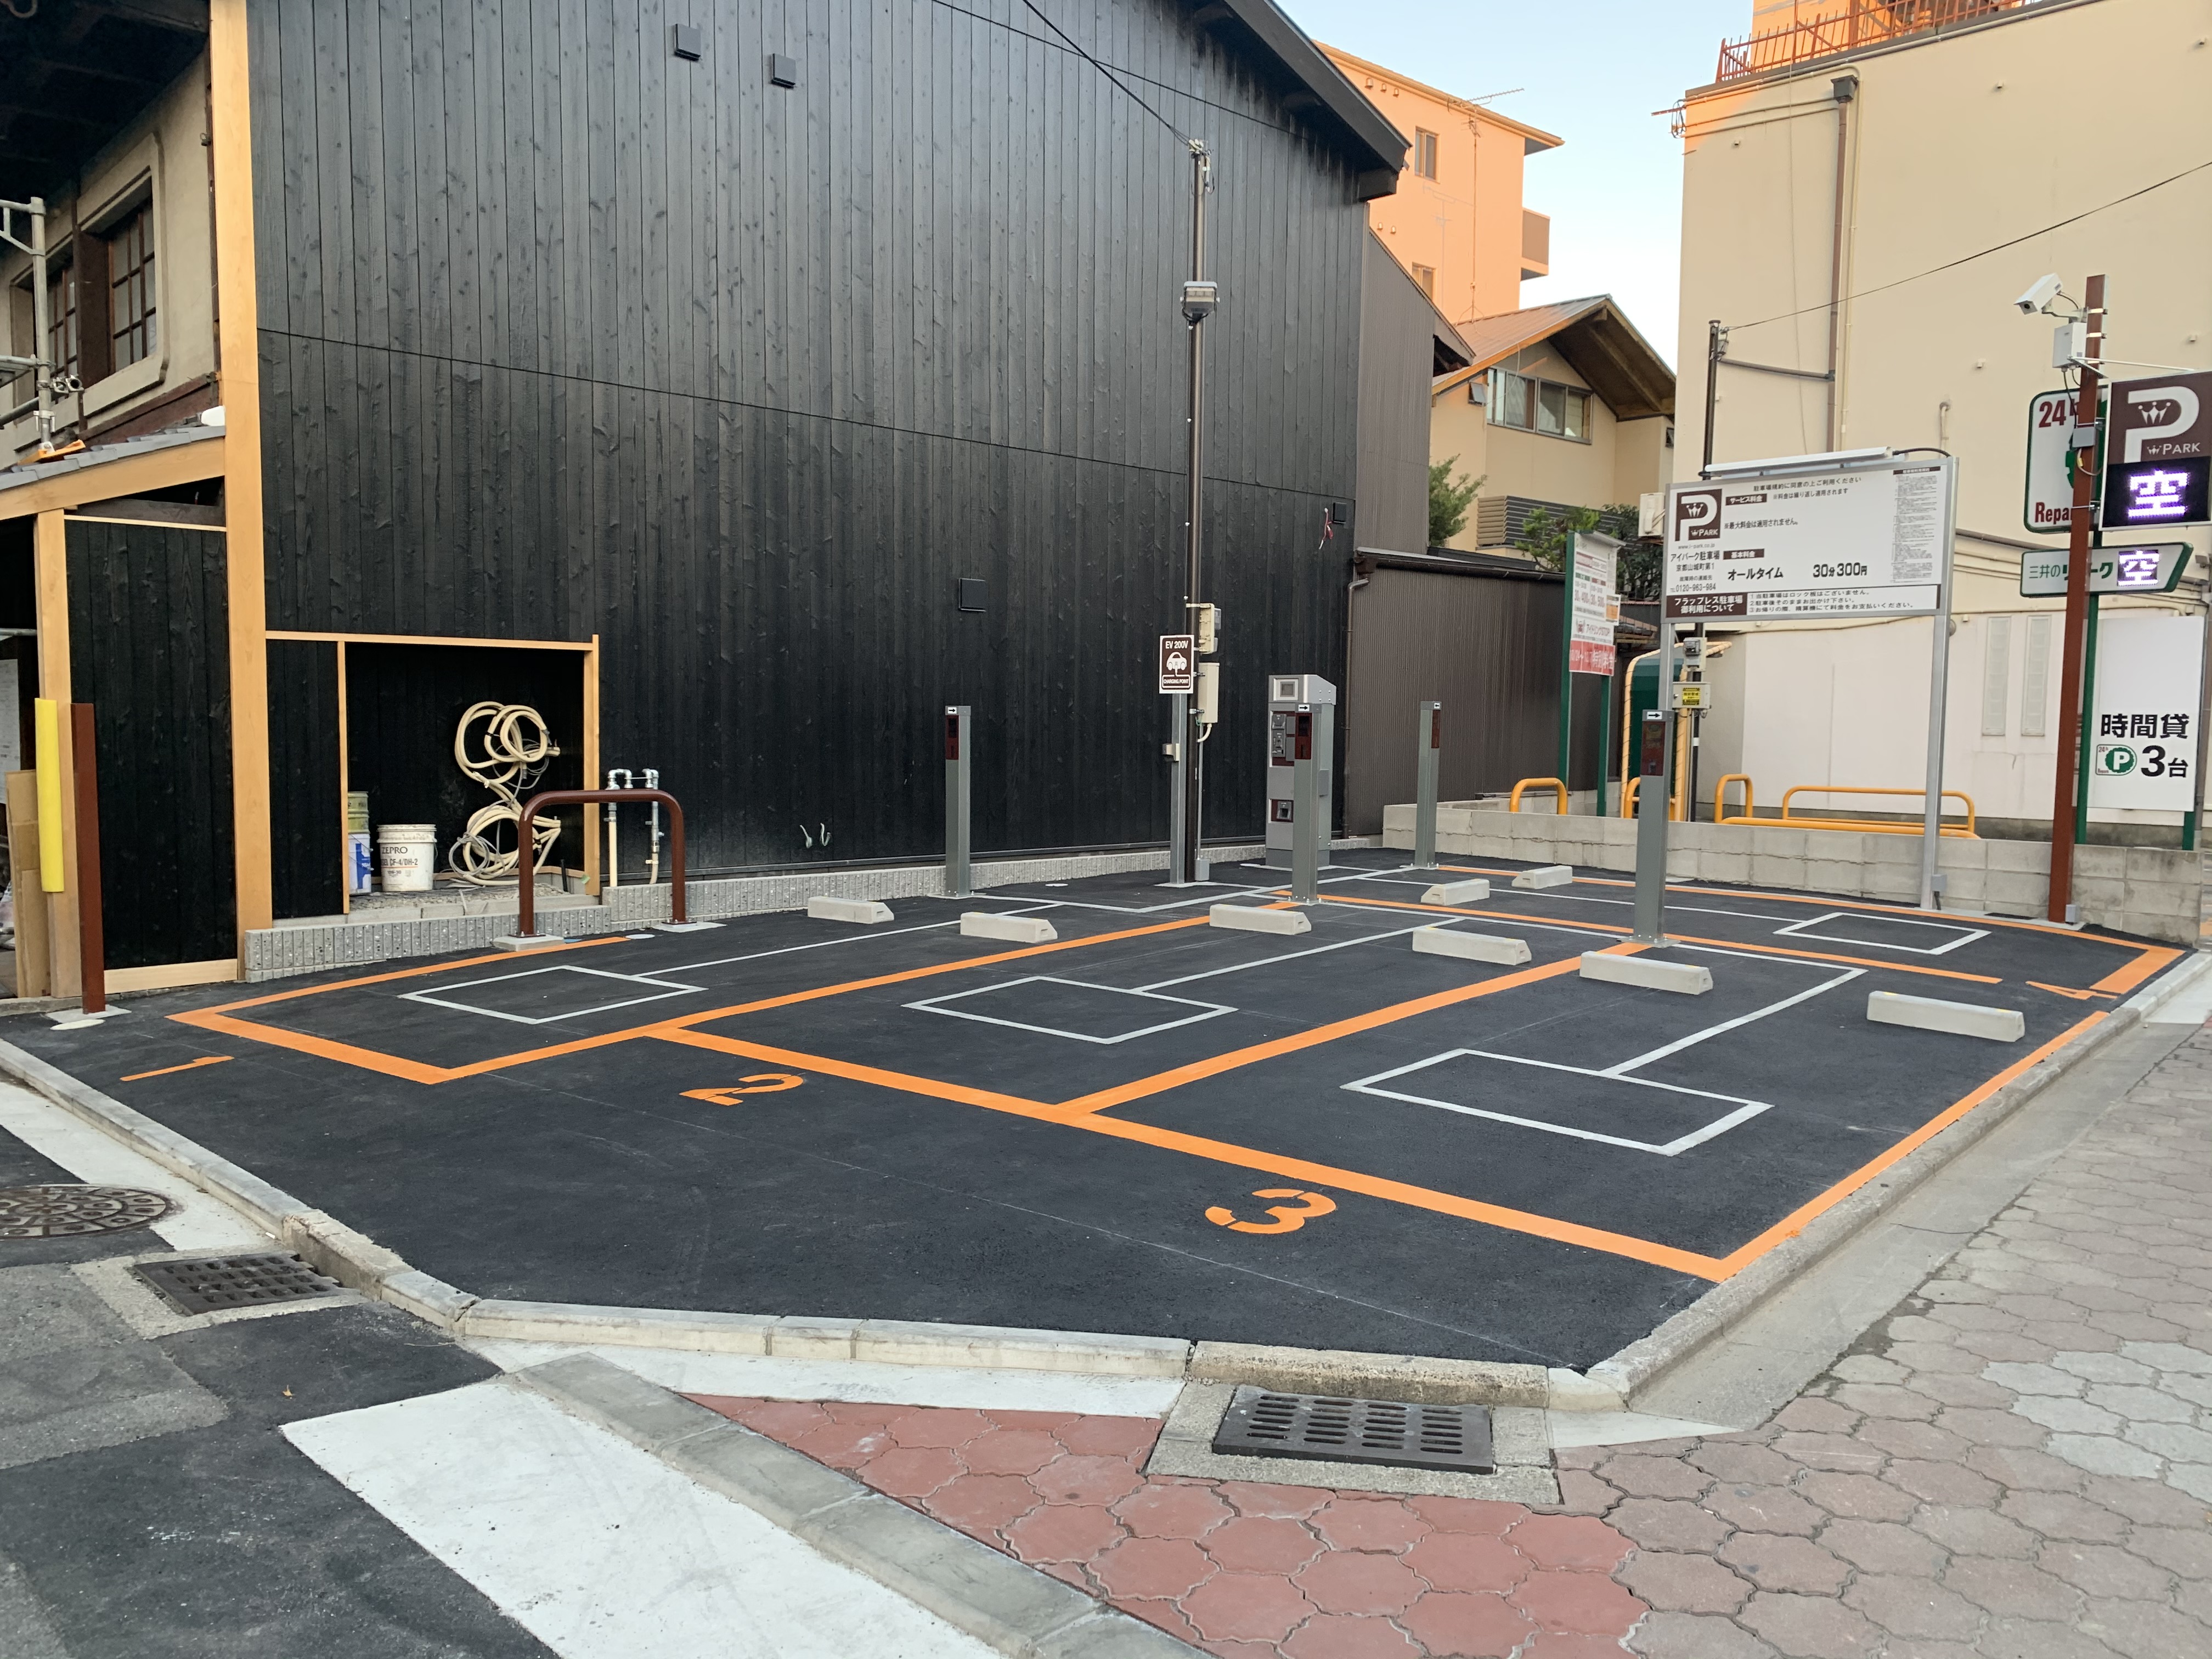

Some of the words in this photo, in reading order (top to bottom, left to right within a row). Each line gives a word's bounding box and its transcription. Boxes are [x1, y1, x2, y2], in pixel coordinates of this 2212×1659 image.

[2163, 443, 2200, 455] PARK
[1730, 495, 1763, 504] サービス料金
[2128, 470, 2190, 518] 空
[2035, 501, 2072, 524] Repa
[1728, 567, 1784, 581] オールタイム
[2117, 550, 2160, 586] 空
[1674, 595, 1743, 606] フラップレス駐車場
[1680, 604, 1734, 614] 御利用について
[1165, 641, 1173, 649] EV
[1174, 640, 1189, 649] 200V
[2101, 714, 2190, 739] 時間貸
[381, 846, 408, 854] ZEPRO
[679, 1073, 804, 1106] 2
[1205, 1188, 1336, 1234] 3
